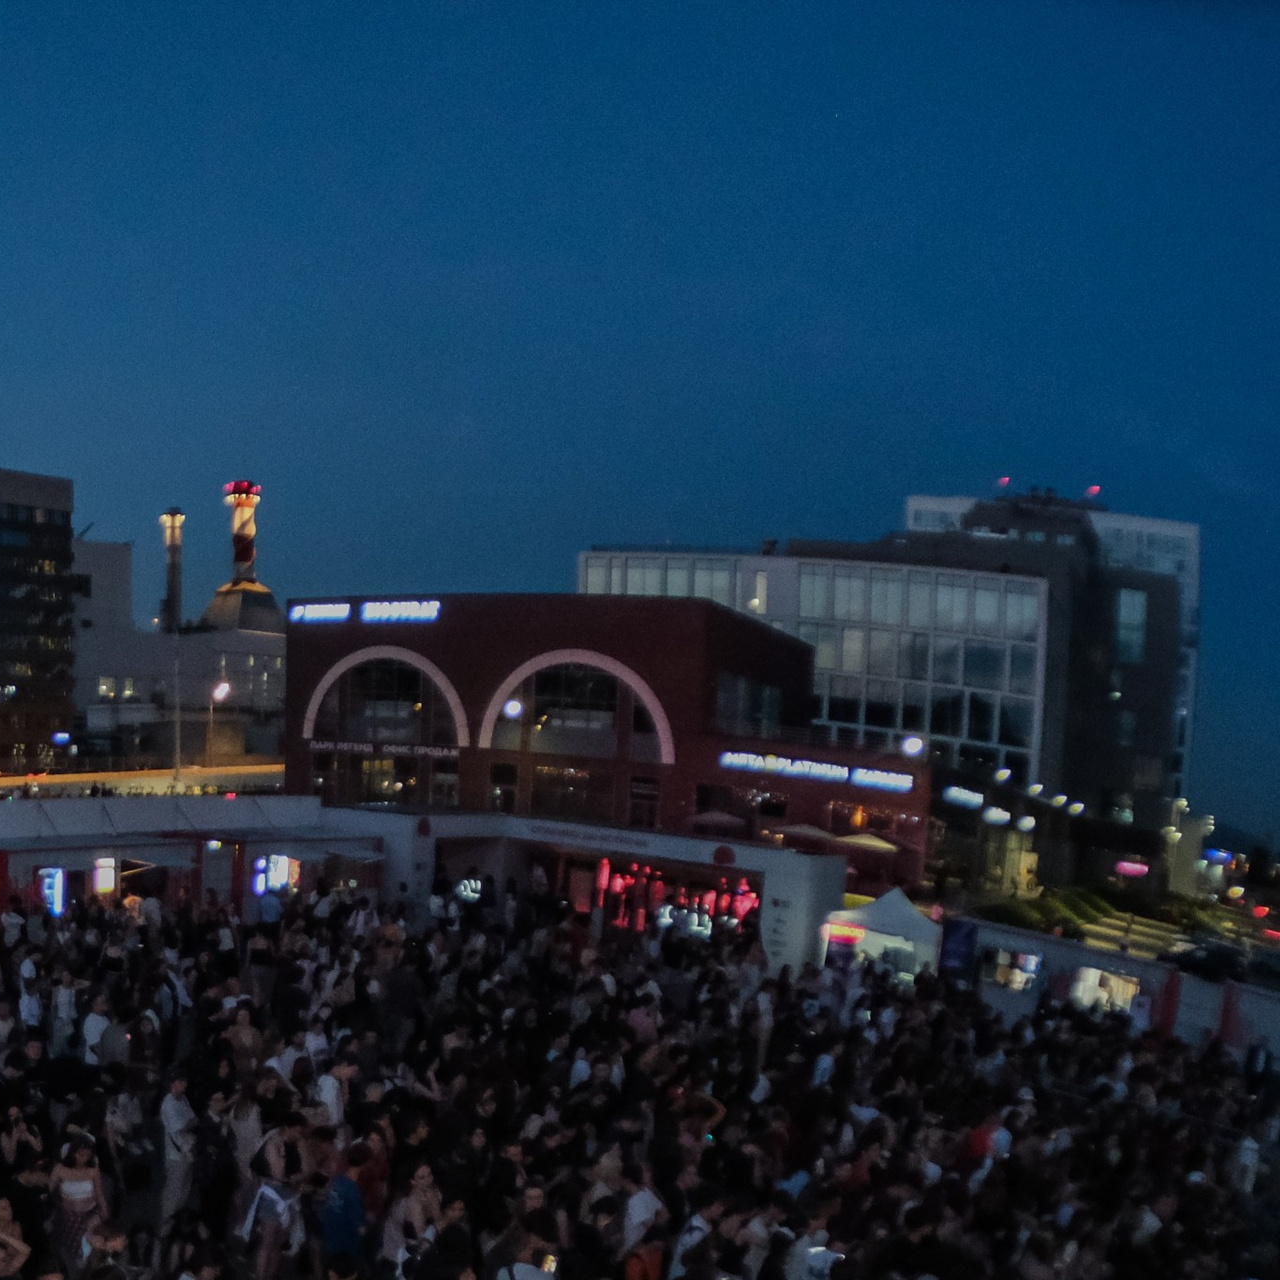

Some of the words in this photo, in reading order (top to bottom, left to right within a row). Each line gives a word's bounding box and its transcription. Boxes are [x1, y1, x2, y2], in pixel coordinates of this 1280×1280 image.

[309, 740, 335, 750] ПАРК
[382, 743, 411, 753] ОФИС
[413, 745, 460, 758] ПРОДАЖ
[775, 757, 849, 779] PLATINUM
